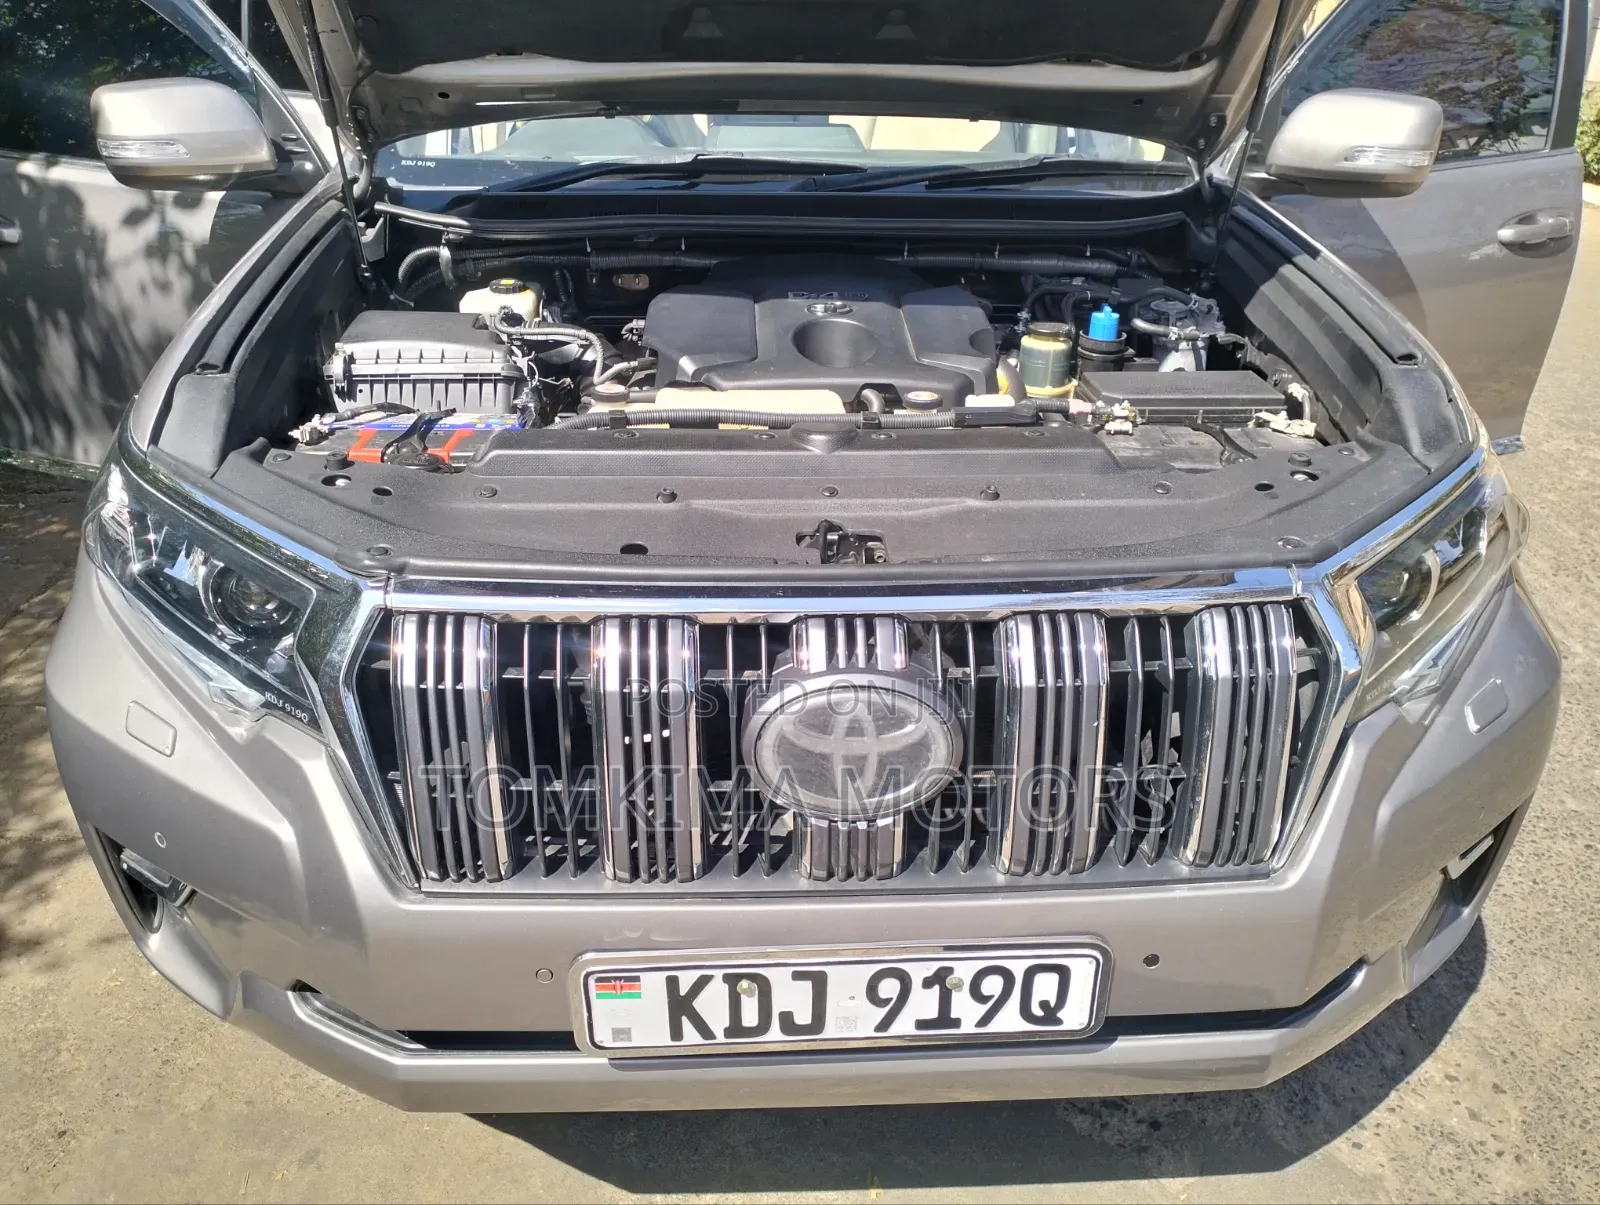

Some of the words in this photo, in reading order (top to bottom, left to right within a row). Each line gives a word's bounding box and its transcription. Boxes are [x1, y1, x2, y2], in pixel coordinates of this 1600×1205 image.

[417, 160, 436, 168] 919Q
[265, 691, 283, 708] KDJ
[284, 703, 309, 725] 919Q
[664, 969, 829, 1042] KDJ
[864, 963, 1073, 1034] 919Q
